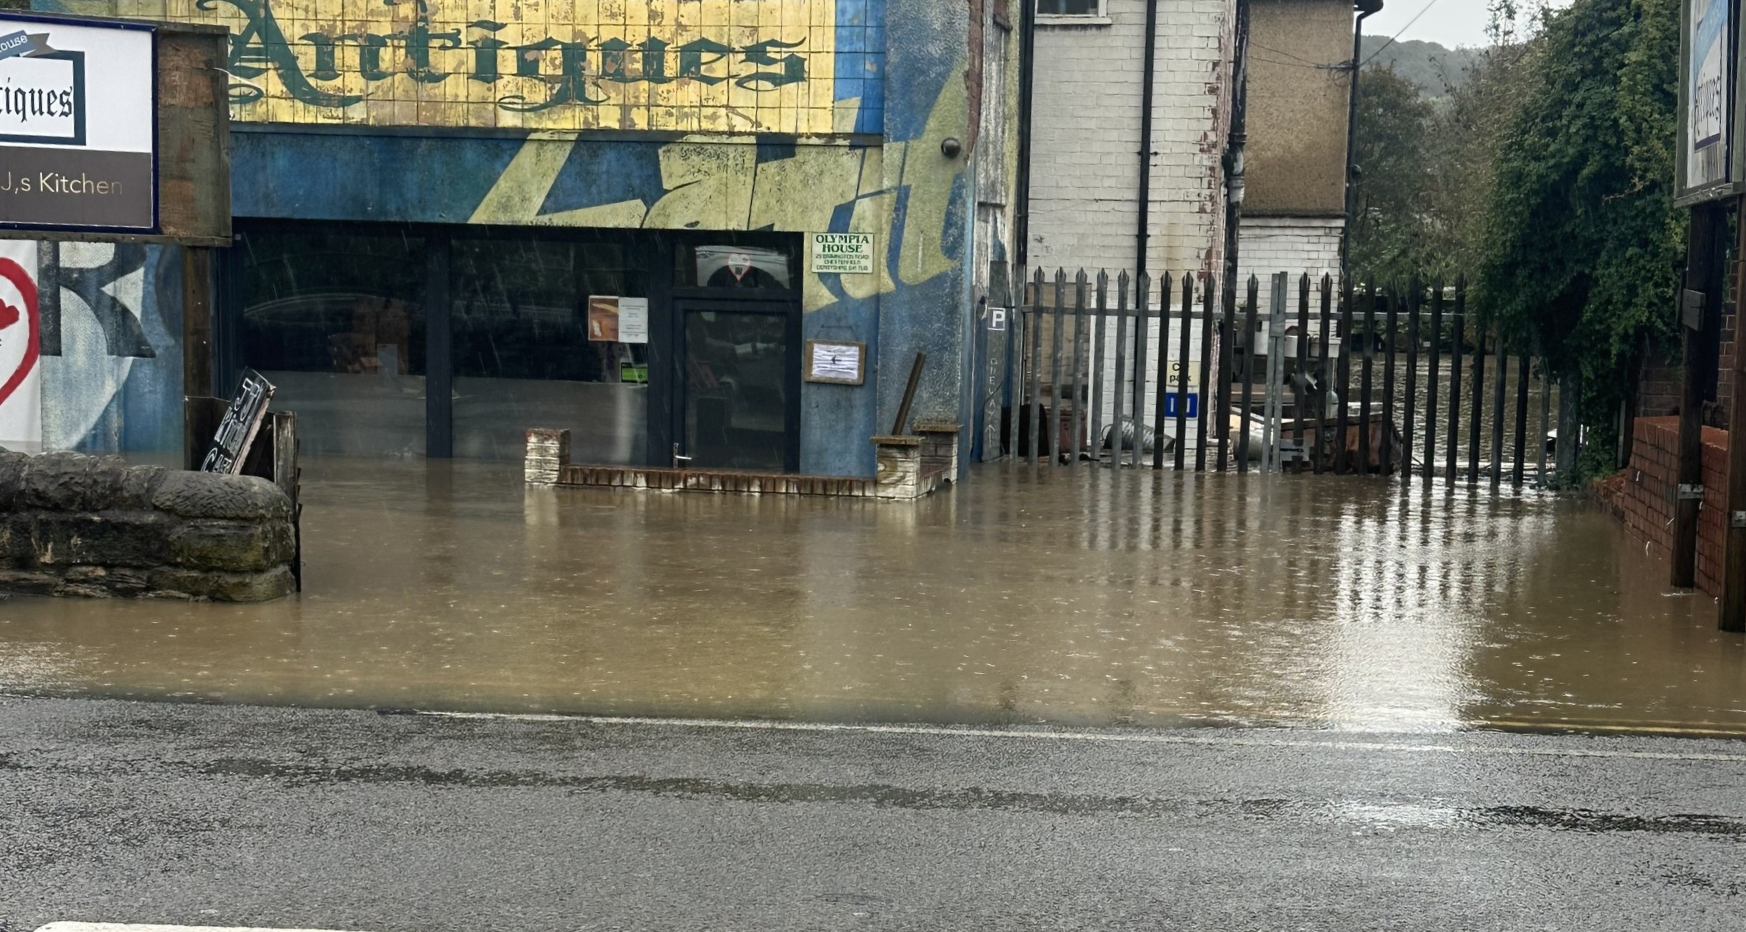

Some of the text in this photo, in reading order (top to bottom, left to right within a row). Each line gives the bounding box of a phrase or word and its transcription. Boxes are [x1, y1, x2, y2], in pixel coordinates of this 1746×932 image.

[0, 35, 28, 52] ouse
[196, 0, 807, 112] Antiques
[39, 171, 123, 194] Kitchen
[816, 234, 870, 243] OLYMPIA
[822, 244, 863, 253] HOUSE
[992, 310, 1005, 328] P
